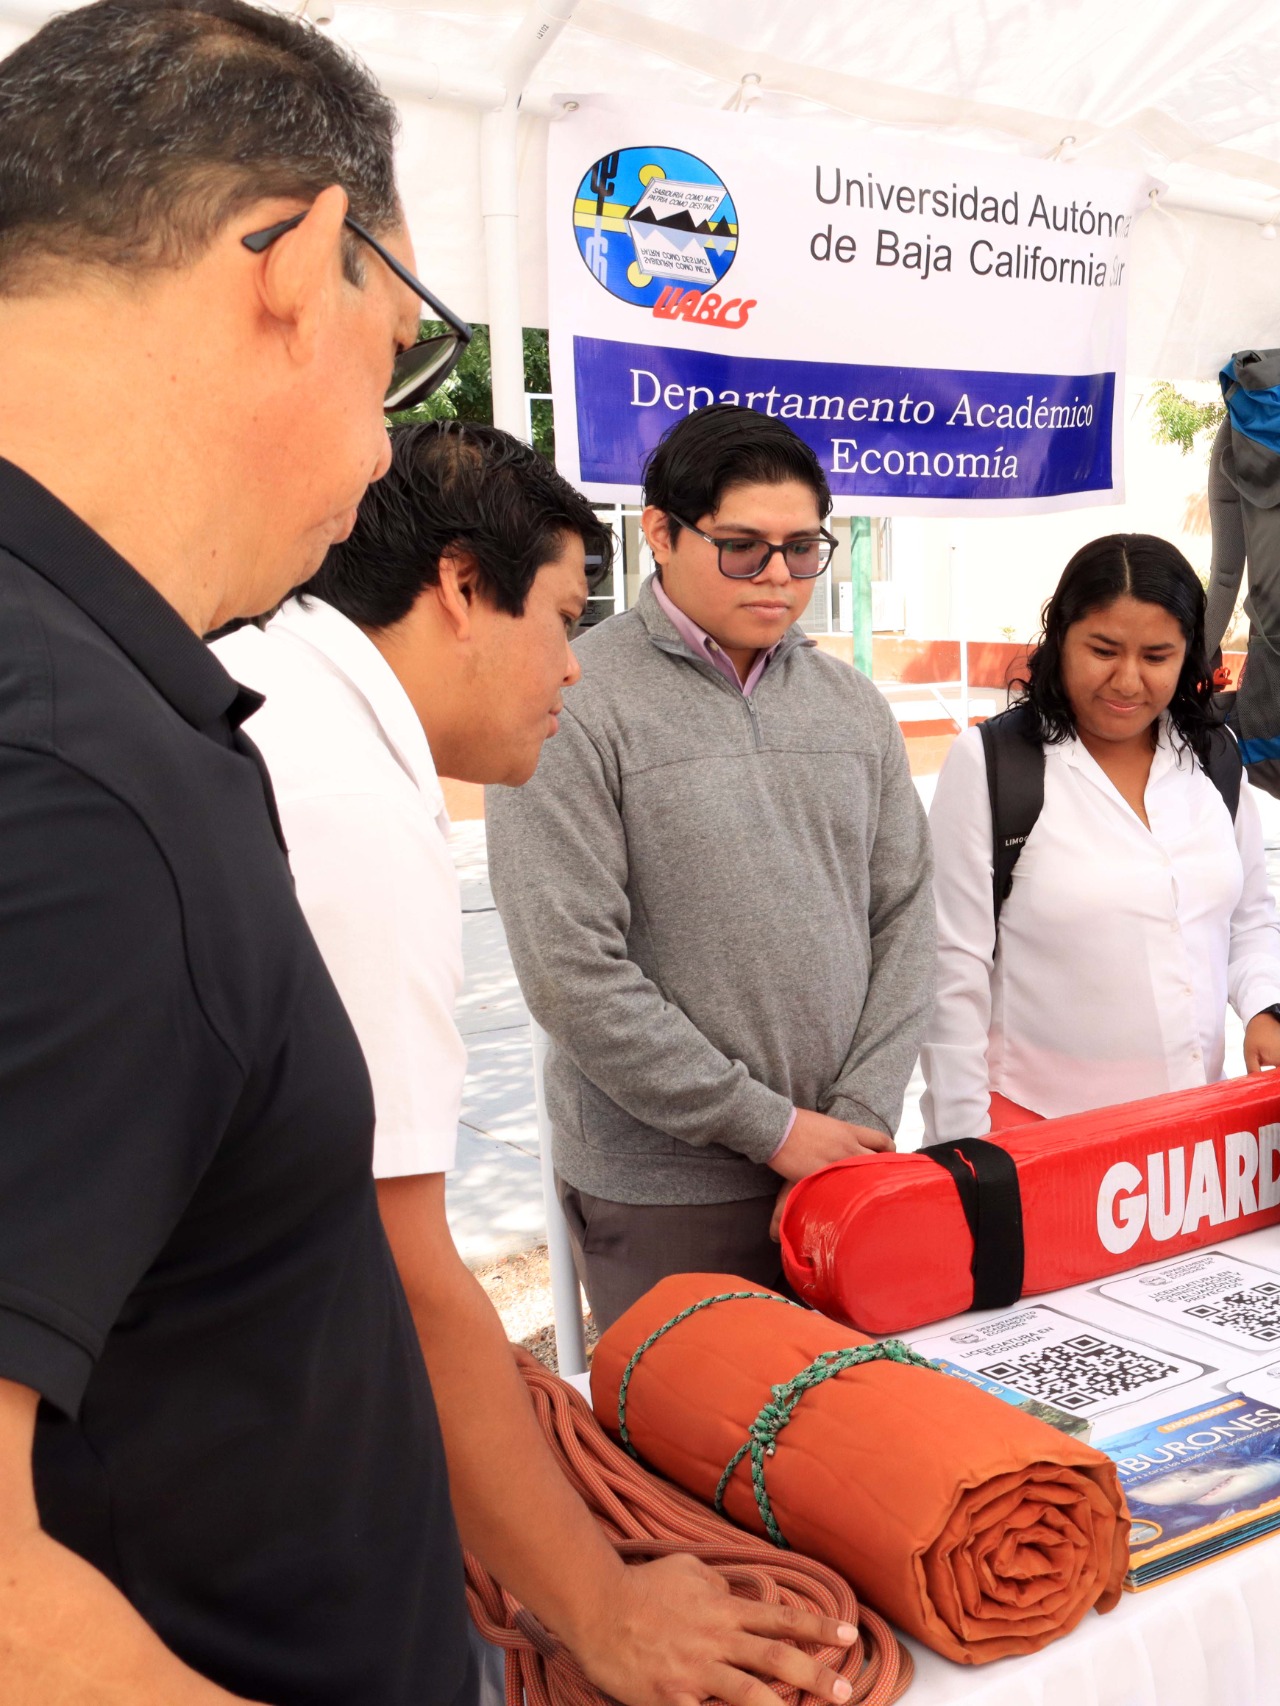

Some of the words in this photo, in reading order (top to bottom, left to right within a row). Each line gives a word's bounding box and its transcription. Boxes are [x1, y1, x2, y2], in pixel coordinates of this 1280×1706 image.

[647, 194, 668, 203] PATRIA
[669, 199, 688, 207] COMO
[815, 164, 1020, 226] Universidad
[1028, 194, 1131, 238] Autóna
[810, 224, 858, 264] de
[875, 232, 952, 280] Baja
[969, 240, 1107, 287] California
[653, 285, 757, 329] UABCS
[629, 368, 935, 424] Departamento
[946, 395, 1094, 430] Académico
[830, 438, 1019, 480] Economía
[960, 1331, 1037, 1358] LICENCIATURA
[1037, 1326, 1054, 1334] EN
